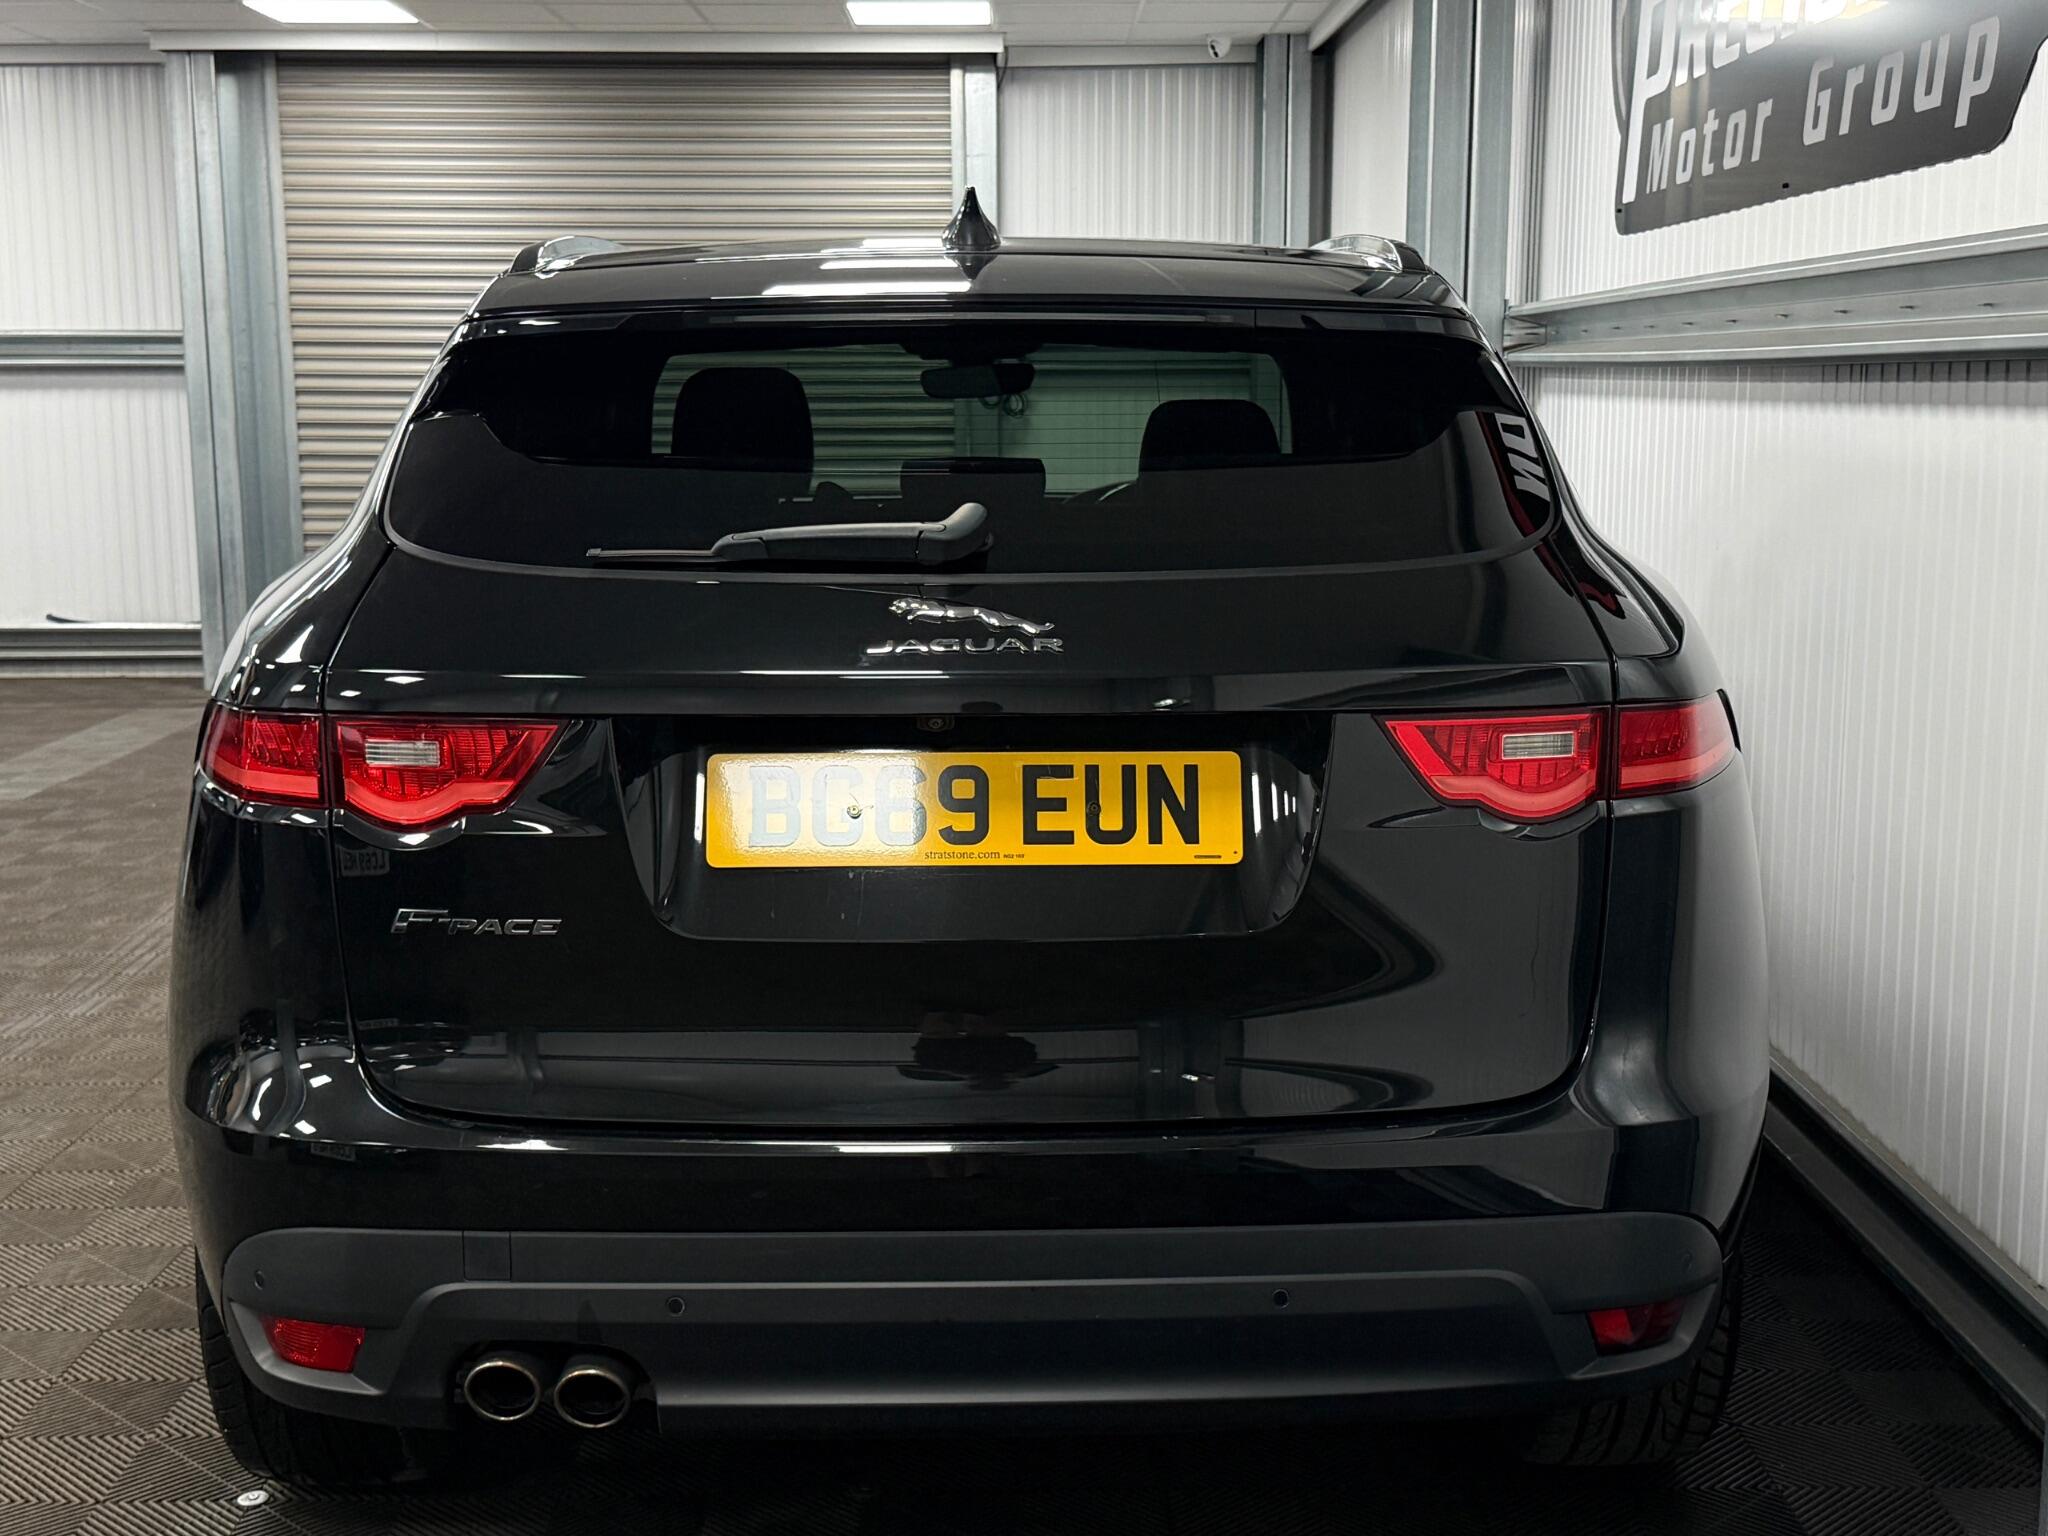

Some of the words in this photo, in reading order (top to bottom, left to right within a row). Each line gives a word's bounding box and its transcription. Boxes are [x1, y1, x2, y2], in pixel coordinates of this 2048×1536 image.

[1646, 98, 1774, 194] Motor
[1802, 16, 2000, 146] Group
[866, 638, 1064, 655] JAGUAR
[1022, 763, 1200, 846] EUN
[924, 850, 1001, 860] stratstone.com
